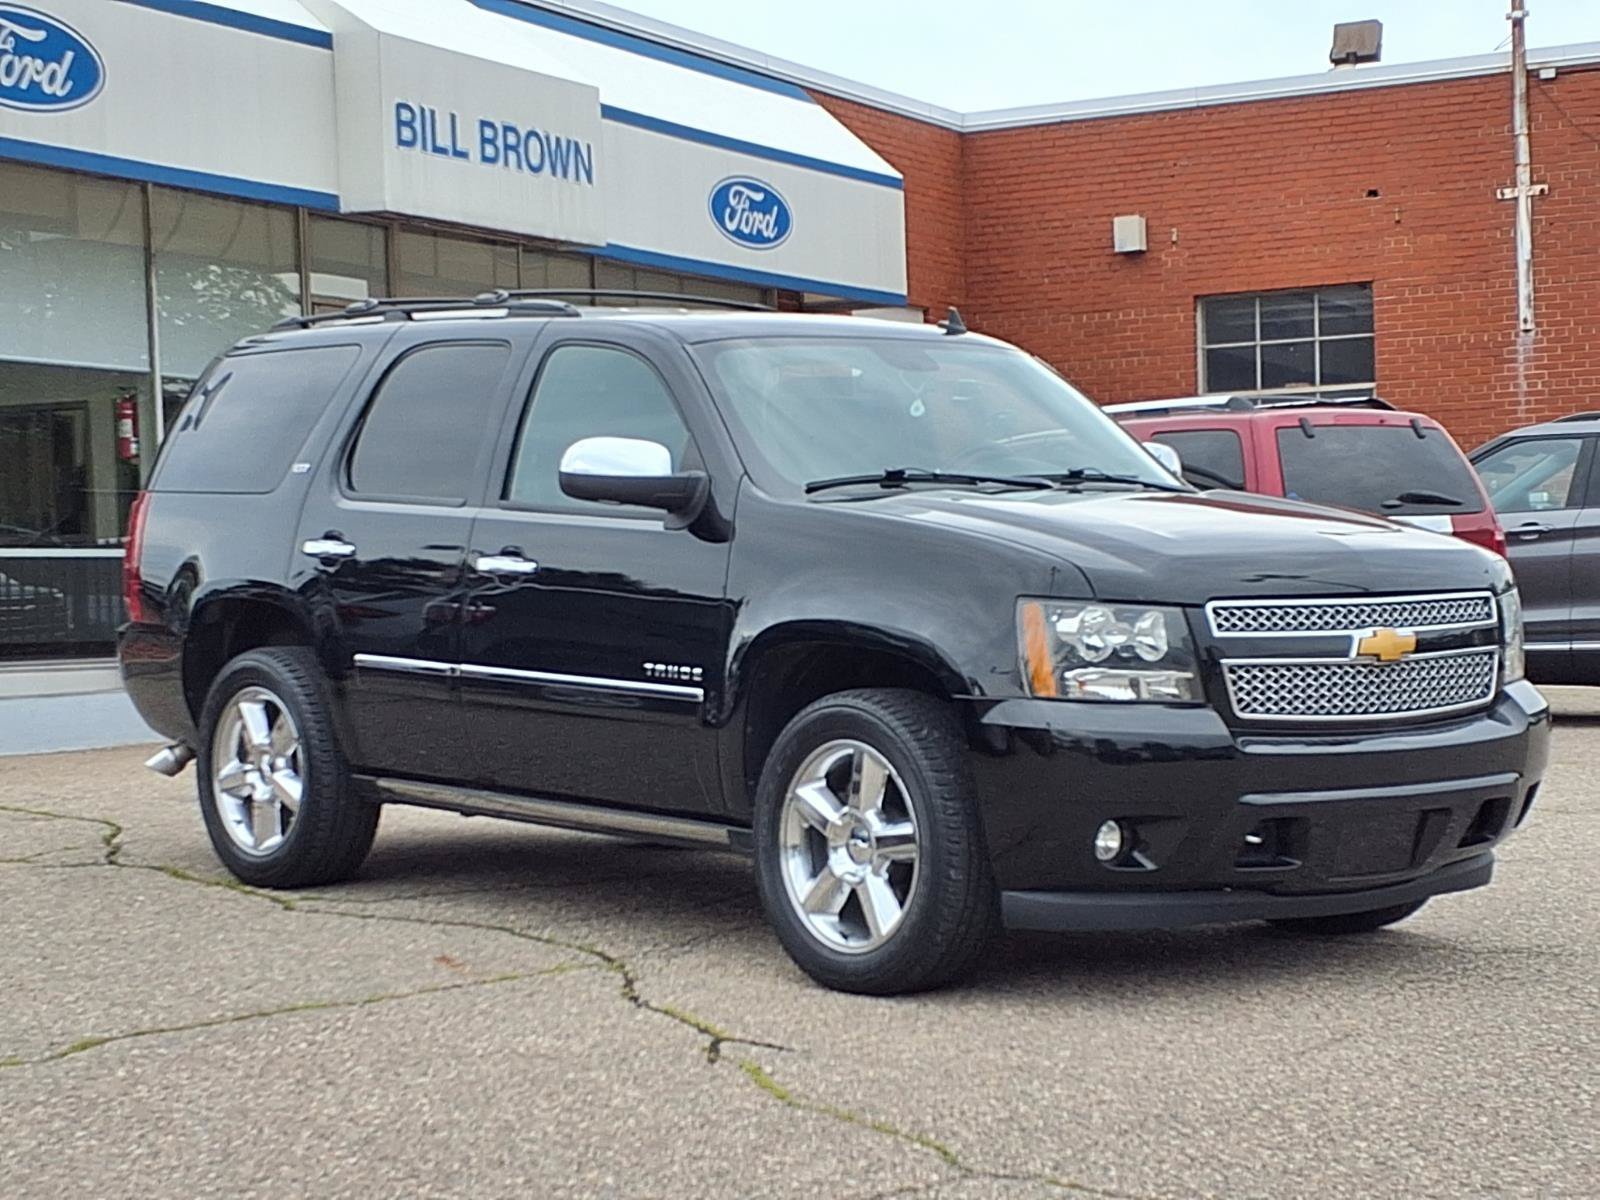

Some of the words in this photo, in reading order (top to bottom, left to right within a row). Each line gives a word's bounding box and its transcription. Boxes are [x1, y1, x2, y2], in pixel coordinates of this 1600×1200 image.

[395, 102, 469, 160] BILL
[479, 119, 593, 185] BROWN
[724, 185, 778, 239] Ford
